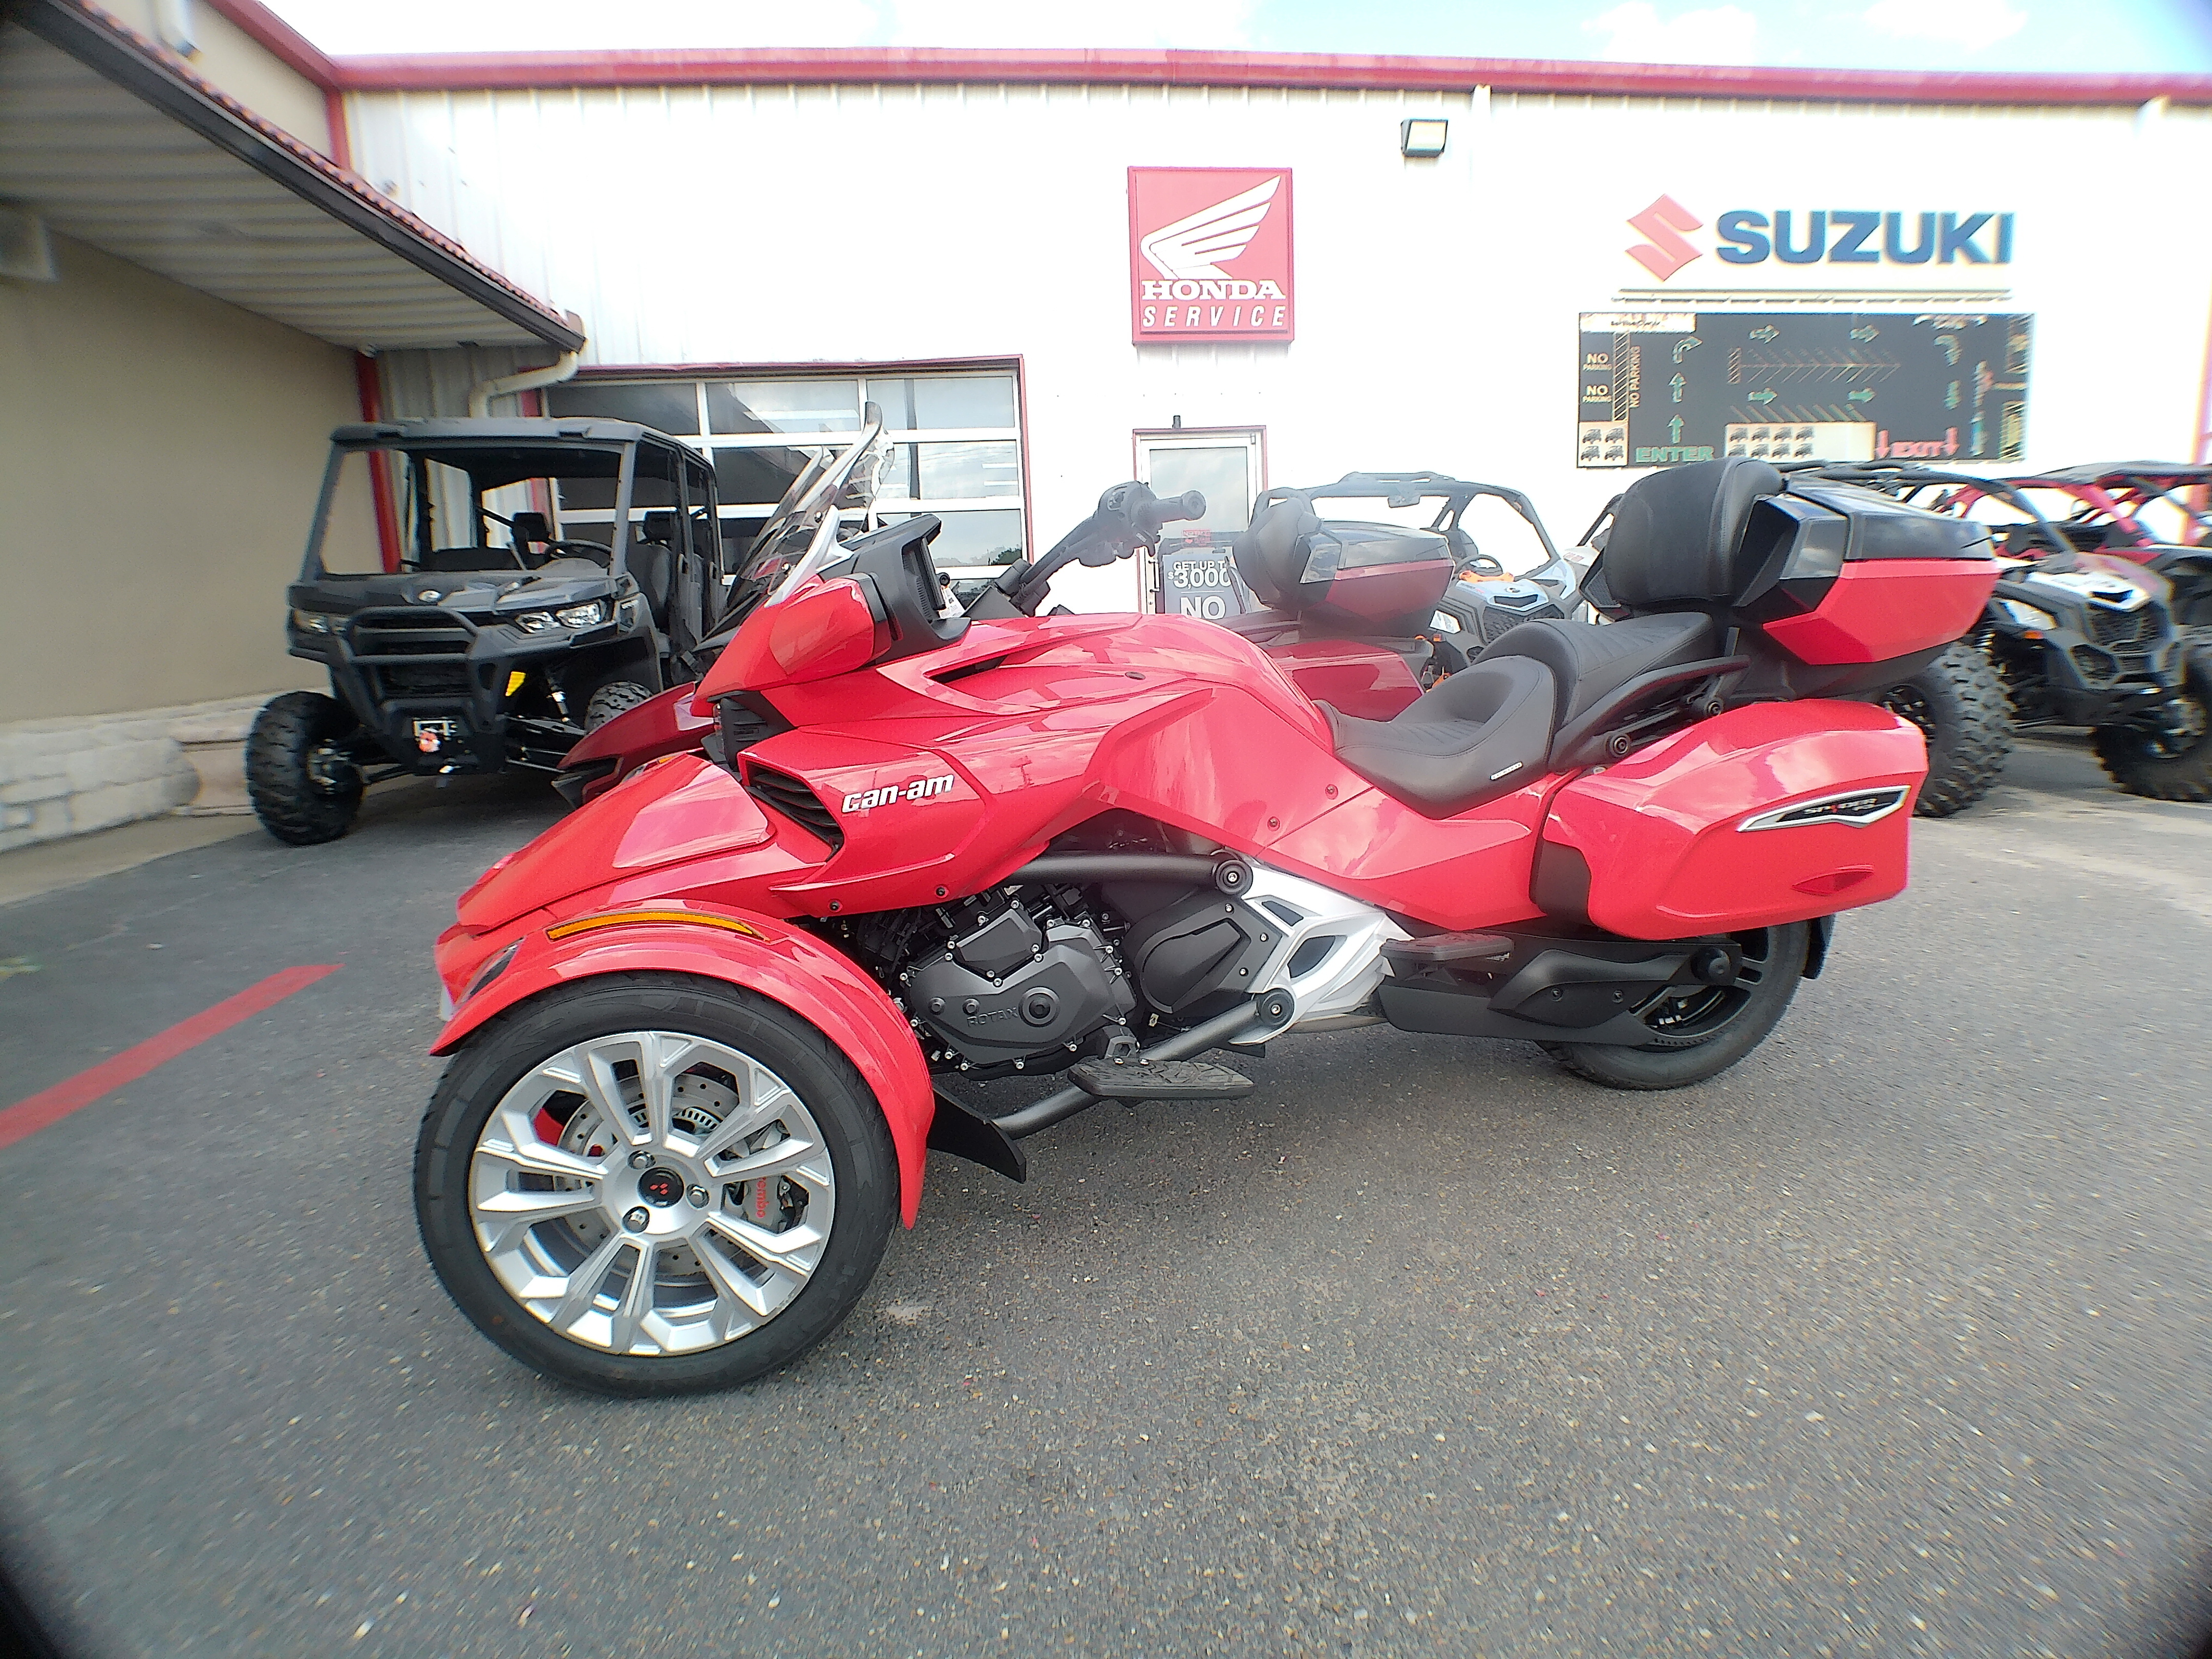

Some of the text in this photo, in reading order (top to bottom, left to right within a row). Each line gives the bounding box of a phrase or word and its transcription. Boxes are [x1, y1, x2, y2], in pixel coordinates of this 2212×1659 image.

[1716, 209, 2015, 264] SUZUKI
[1141, 280, 1286, 300] HONDA
[1142, 305, 1286, 327] SERVICE
[1586, 353, 1609, 364] NO
[1629, 346, 1641, 408] NO PARKING
[1586, 385, 1608, 395] NO
[1635, 445, 1714, 462] ENTER
[1890, 441, 1945, 458] EXIT
[1173, 561, 1227, 571] GET UP T
[1180, 595, 1226, 620] NO
[841, 774, 954, 813] can-am
[967, 1007, 1018, 1027] ROTAX
